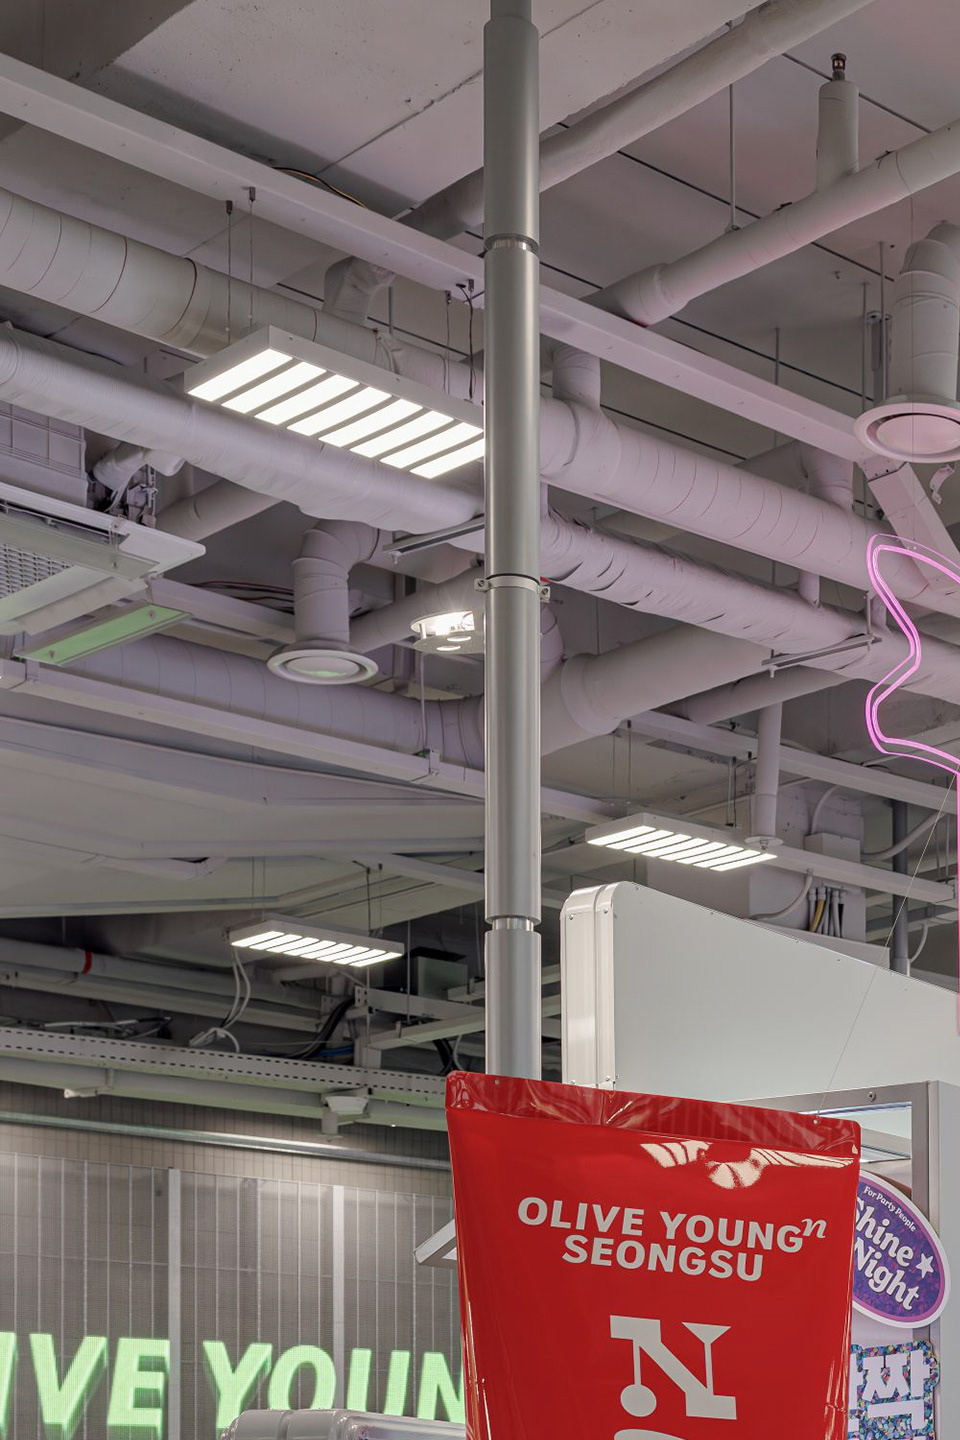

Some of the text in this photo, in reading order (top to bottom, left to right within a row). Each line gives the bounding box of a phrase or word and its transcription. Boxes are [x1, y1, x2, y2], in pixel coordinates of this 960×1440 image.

[517, 1197, 645, 1236] OLIVE
[863, 1186, 916, 1232] For Party People
[562, 1234, 764, 1282] SEONGSU
[854, 1237, 919, 1310] Night
